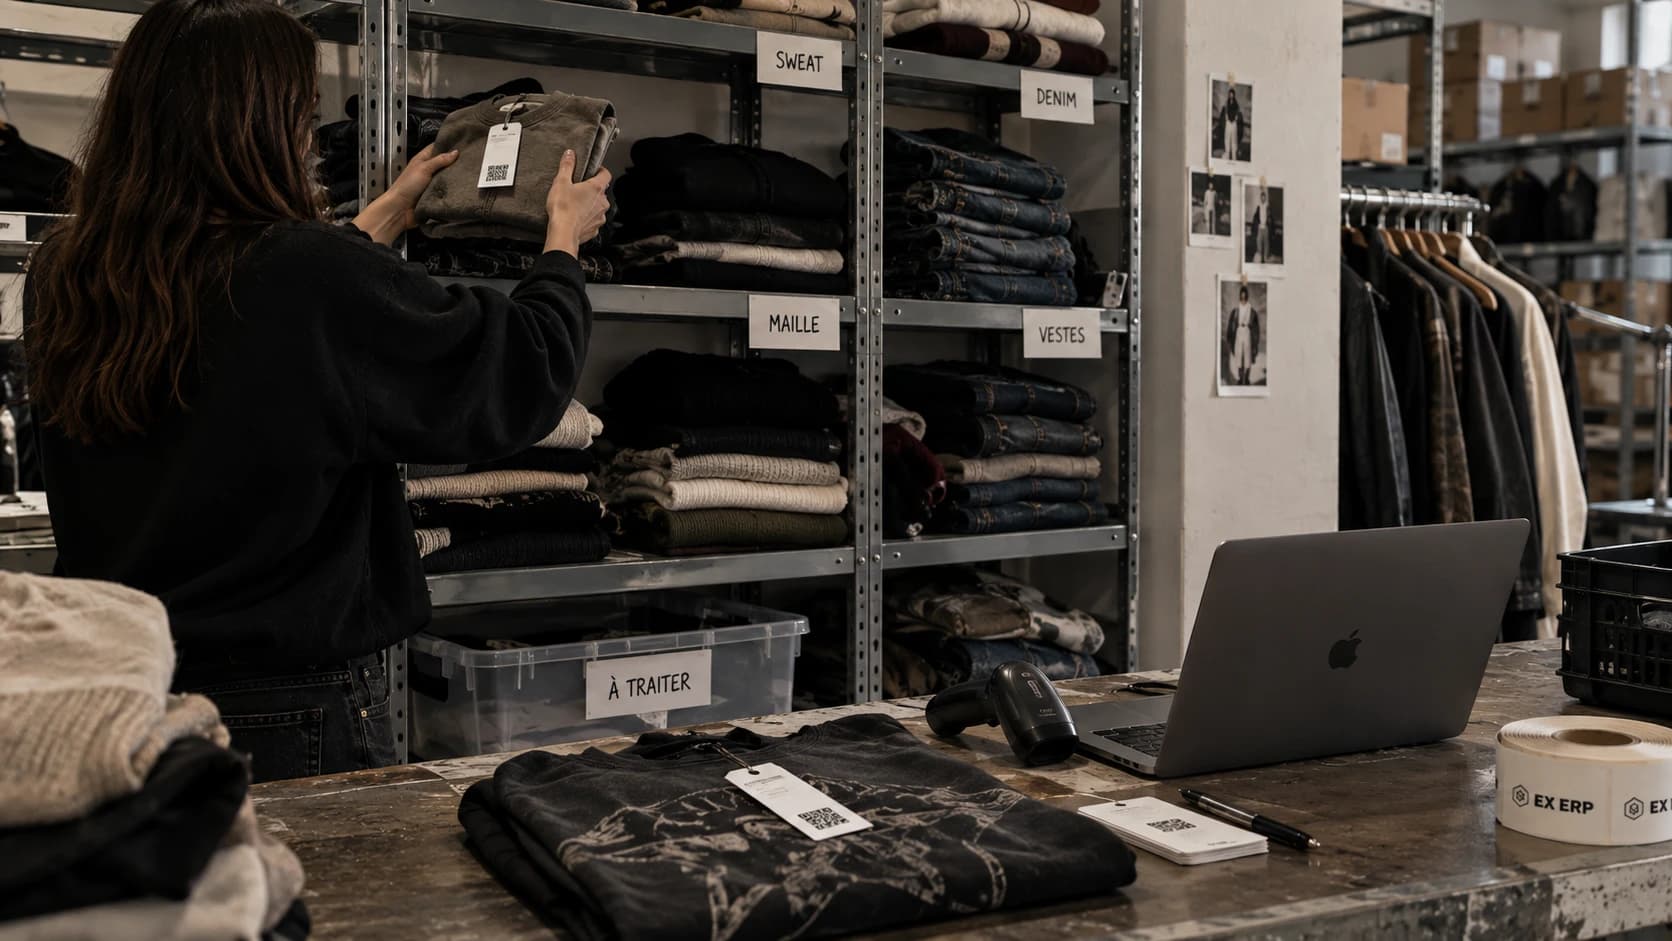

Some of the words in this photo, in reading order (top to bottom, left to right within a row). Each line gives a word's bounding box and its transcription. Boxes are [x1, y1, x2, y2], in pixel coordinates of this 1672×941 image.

[776, 50, 824, 72] SWEAT
[1037, 87, 1077, 109] DENIM
[769, 314, 820, 333] MAILLE
[1038, 326, 1086, 344] VESTES
[608, 675, 619, 700] À
[626, 672, 691, 697] TRAITER
[1534, 793, 1555, 810] EX
[1559, 798, 1594, 814] ERP
[1650, 798, 1668, 814] EX
